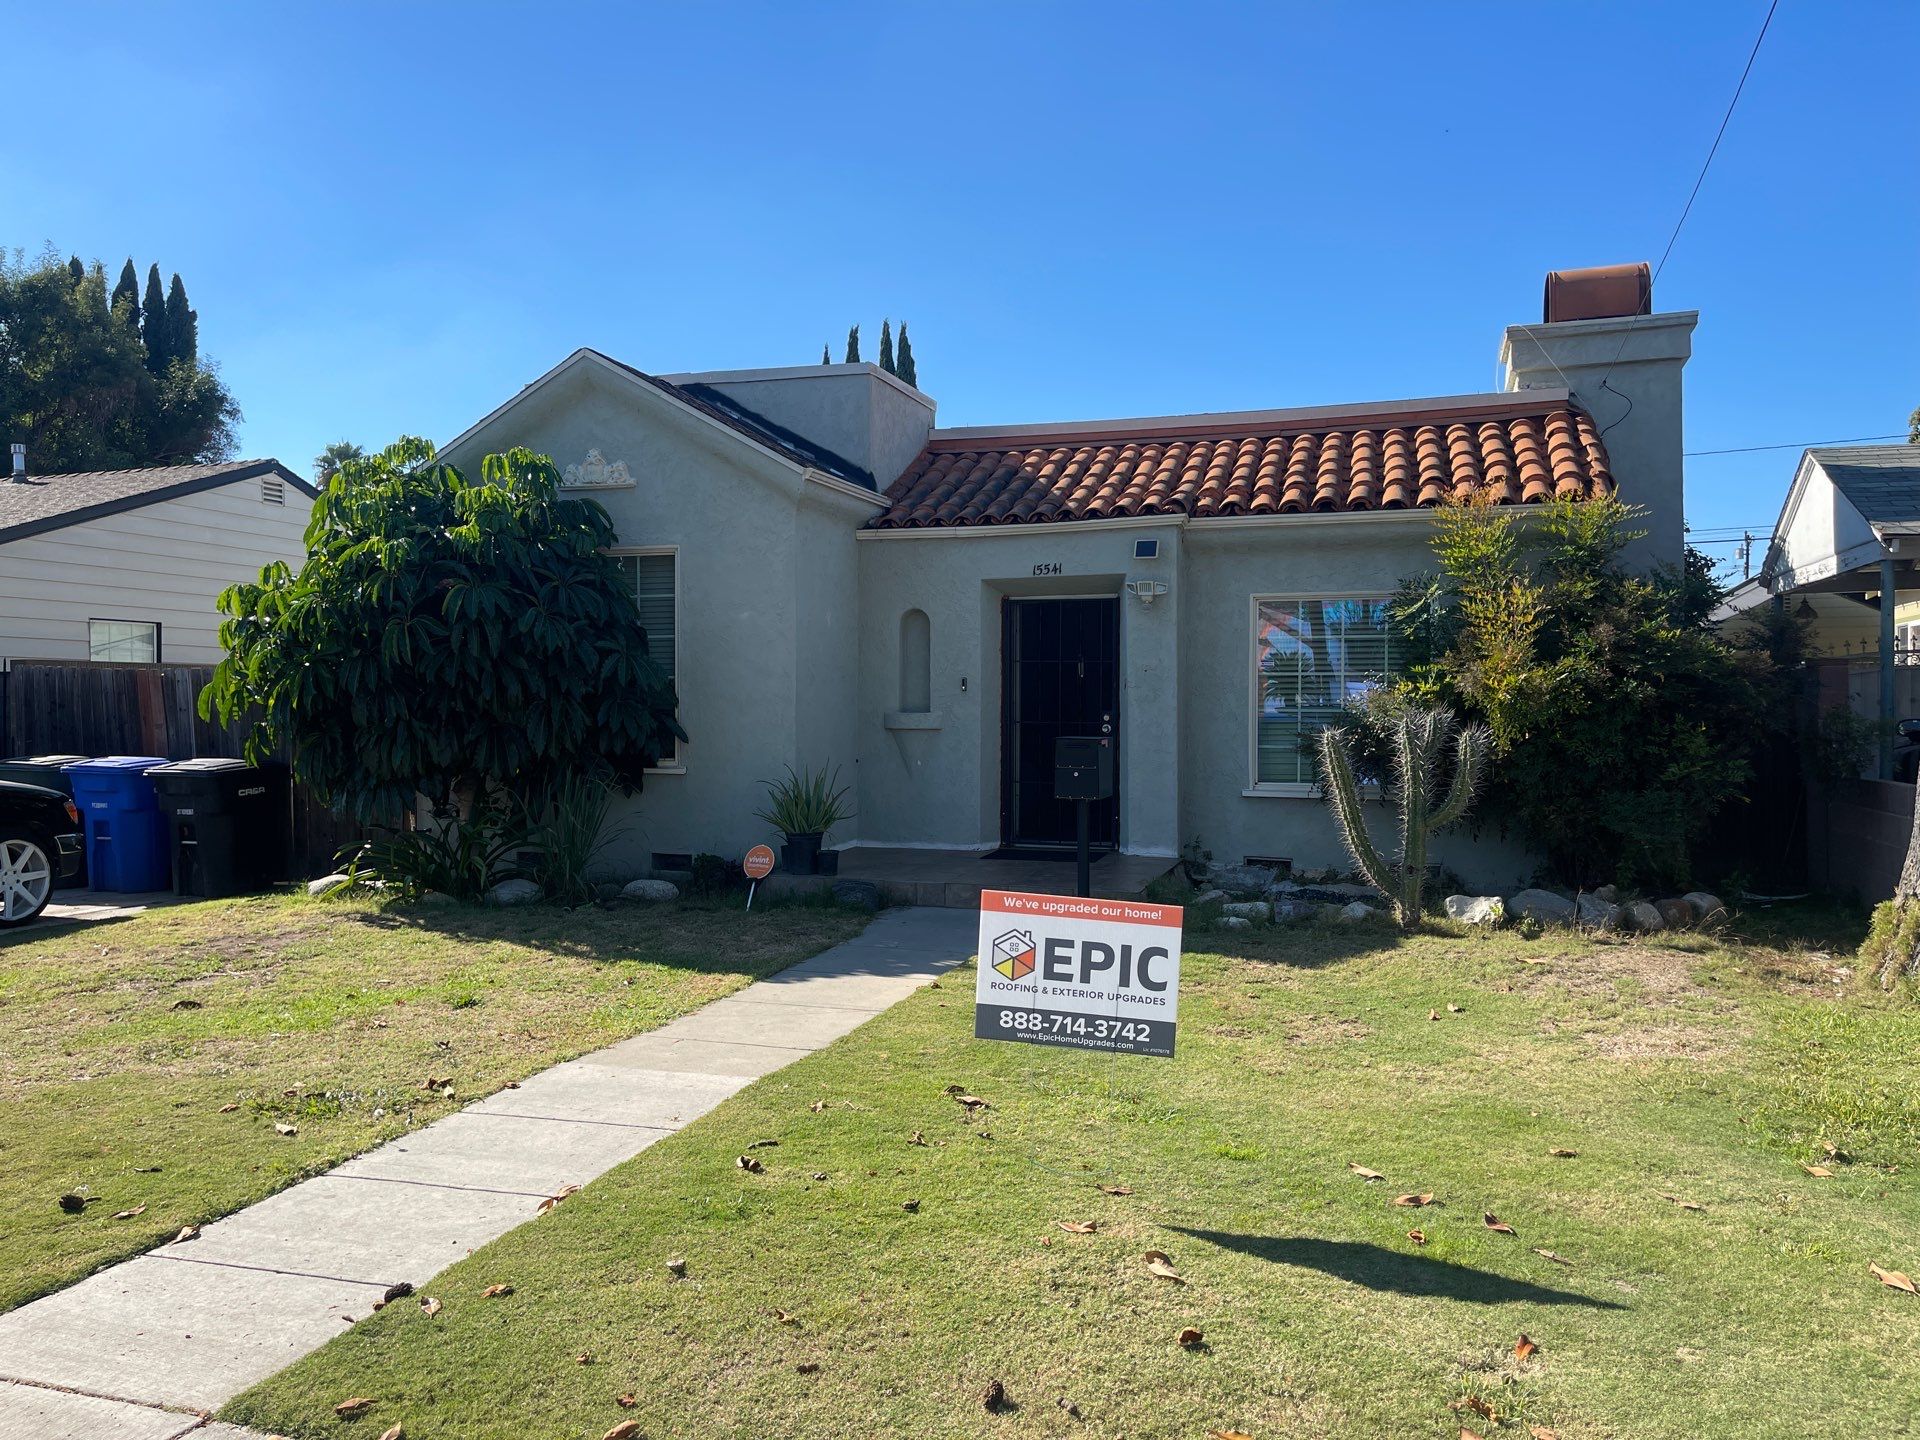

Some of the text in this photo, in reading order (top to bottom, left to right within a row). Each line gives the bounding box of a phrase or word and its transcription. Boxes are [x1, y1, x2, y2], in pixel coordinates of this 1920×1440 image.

[1033, 563, 1062, 576] 15541
[1003, 896, 1162, 920] We've upgraded our home!
[1043, 937, 1169, 992] EPIC
[990, 982, 1038, 994] ROOFING
[1052, 987, 1104, 1000] EXTERIOR
[1107, 992, 1166, 1006] UPGRADES
[999, 1010, 1150, 1042] 888-714-3742
[1016, 1031, 1134, 1050] www.EpicHomeUpgrades.com
